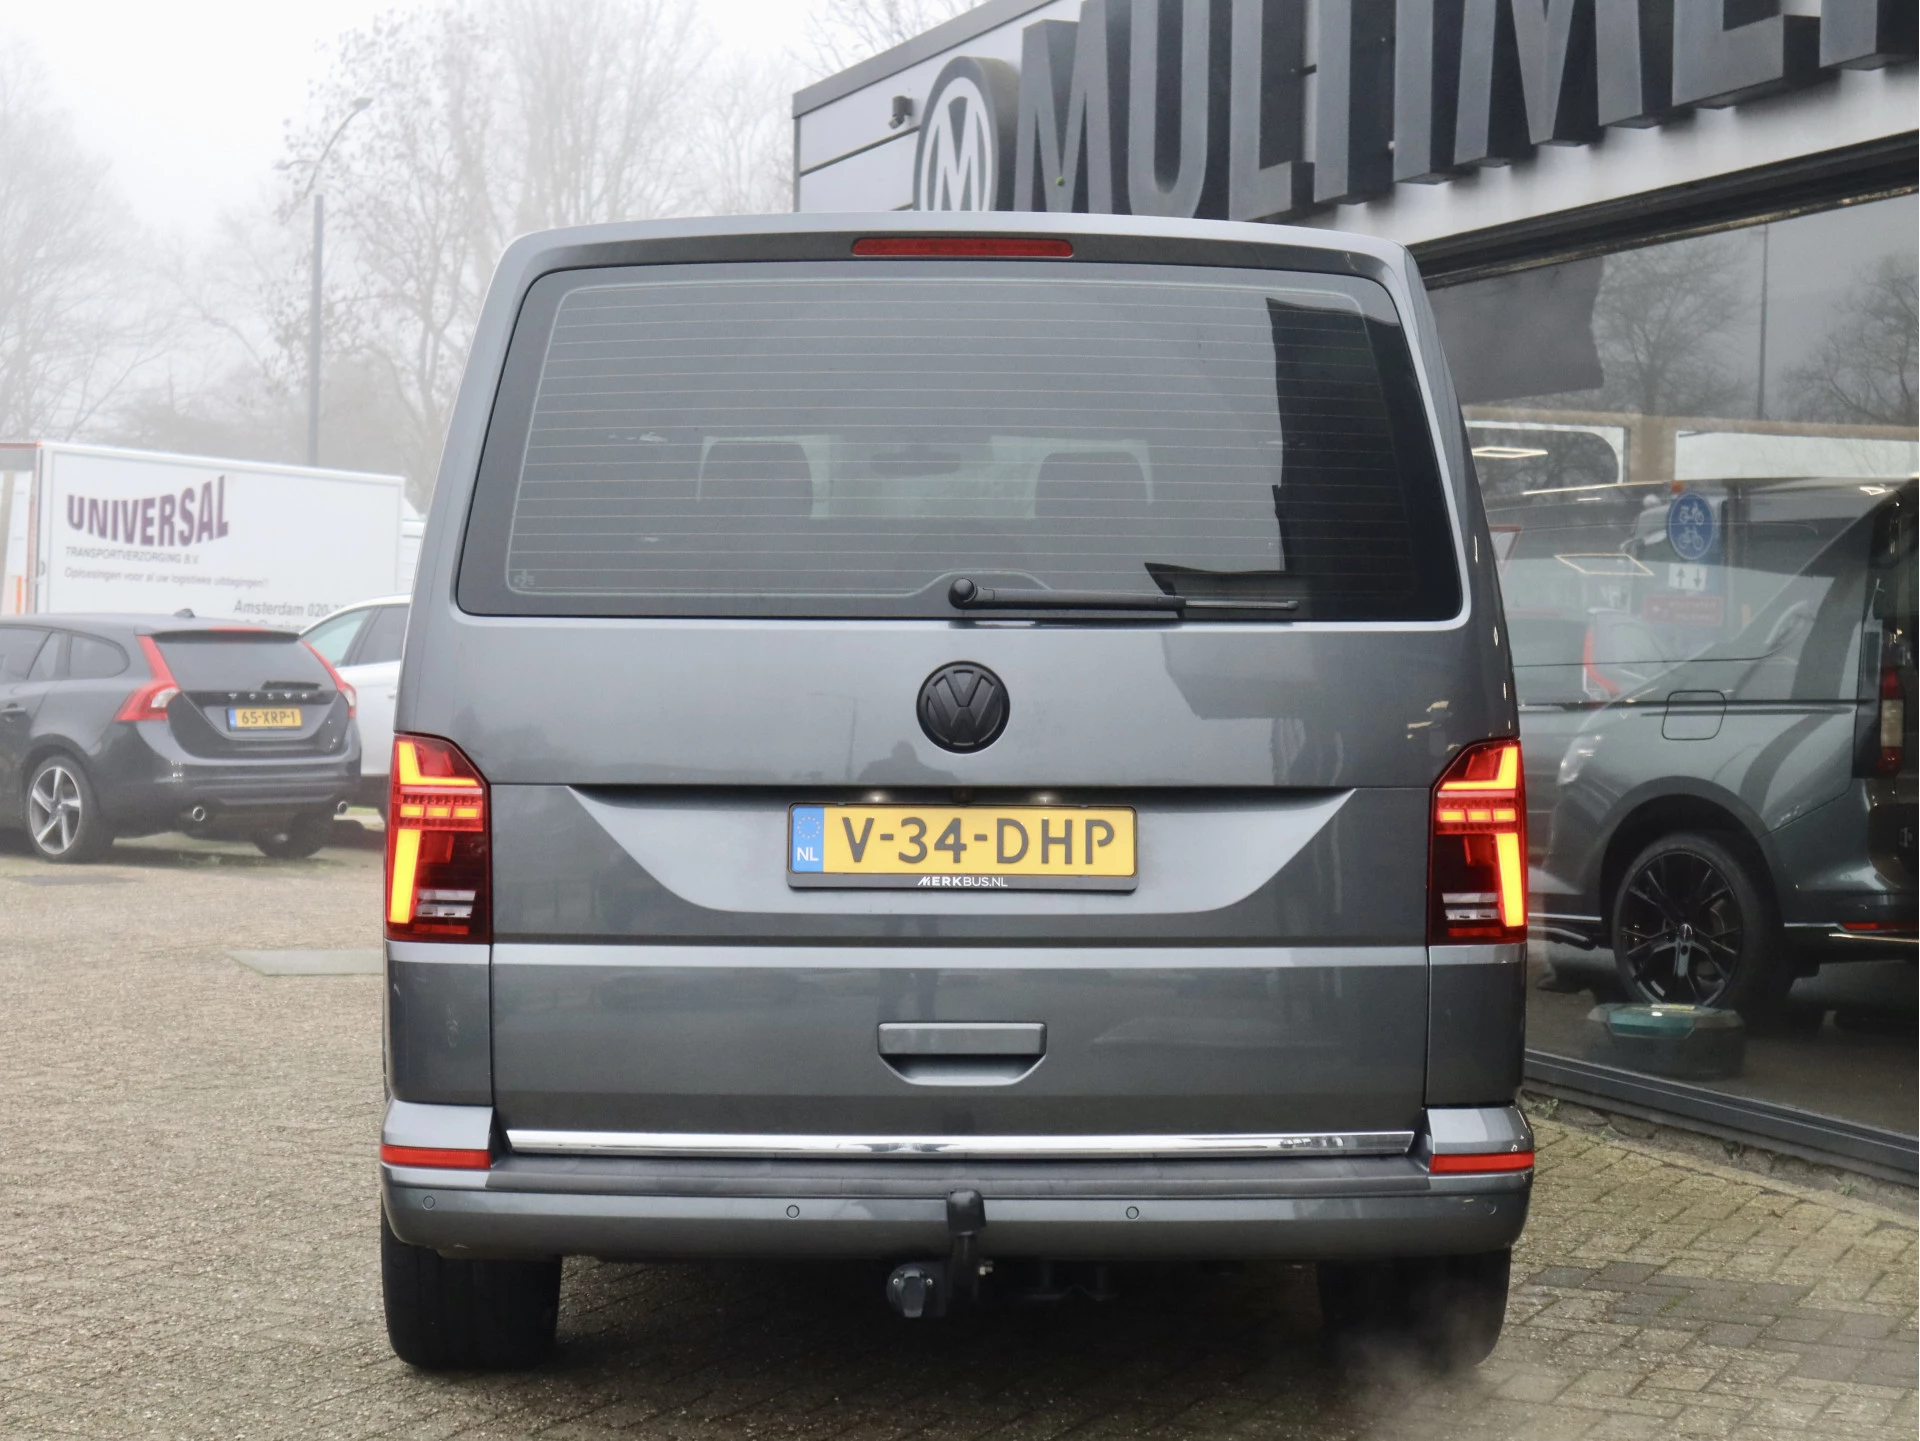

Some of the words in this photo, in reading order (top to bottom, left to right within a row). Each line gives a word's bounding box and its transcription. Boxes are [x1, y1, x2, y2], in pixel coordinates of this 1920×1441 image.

[66, 474, 229, 547] UNIVERSAL
[65, 547, 181, 564] TRANSPORTVERZORGING
[124, 573, 144, 582] voor
[233, 599, 305, 616] Amsterdam
[307, 603, 346, 617] 020-
[241, 711, 297, 725] 65-XRP-1
[841, 816, 1115, 865] V-34-DHP
[796, 846, 819, 862] NL
[917, 876, 1008, 888] MERKBUS.NL
